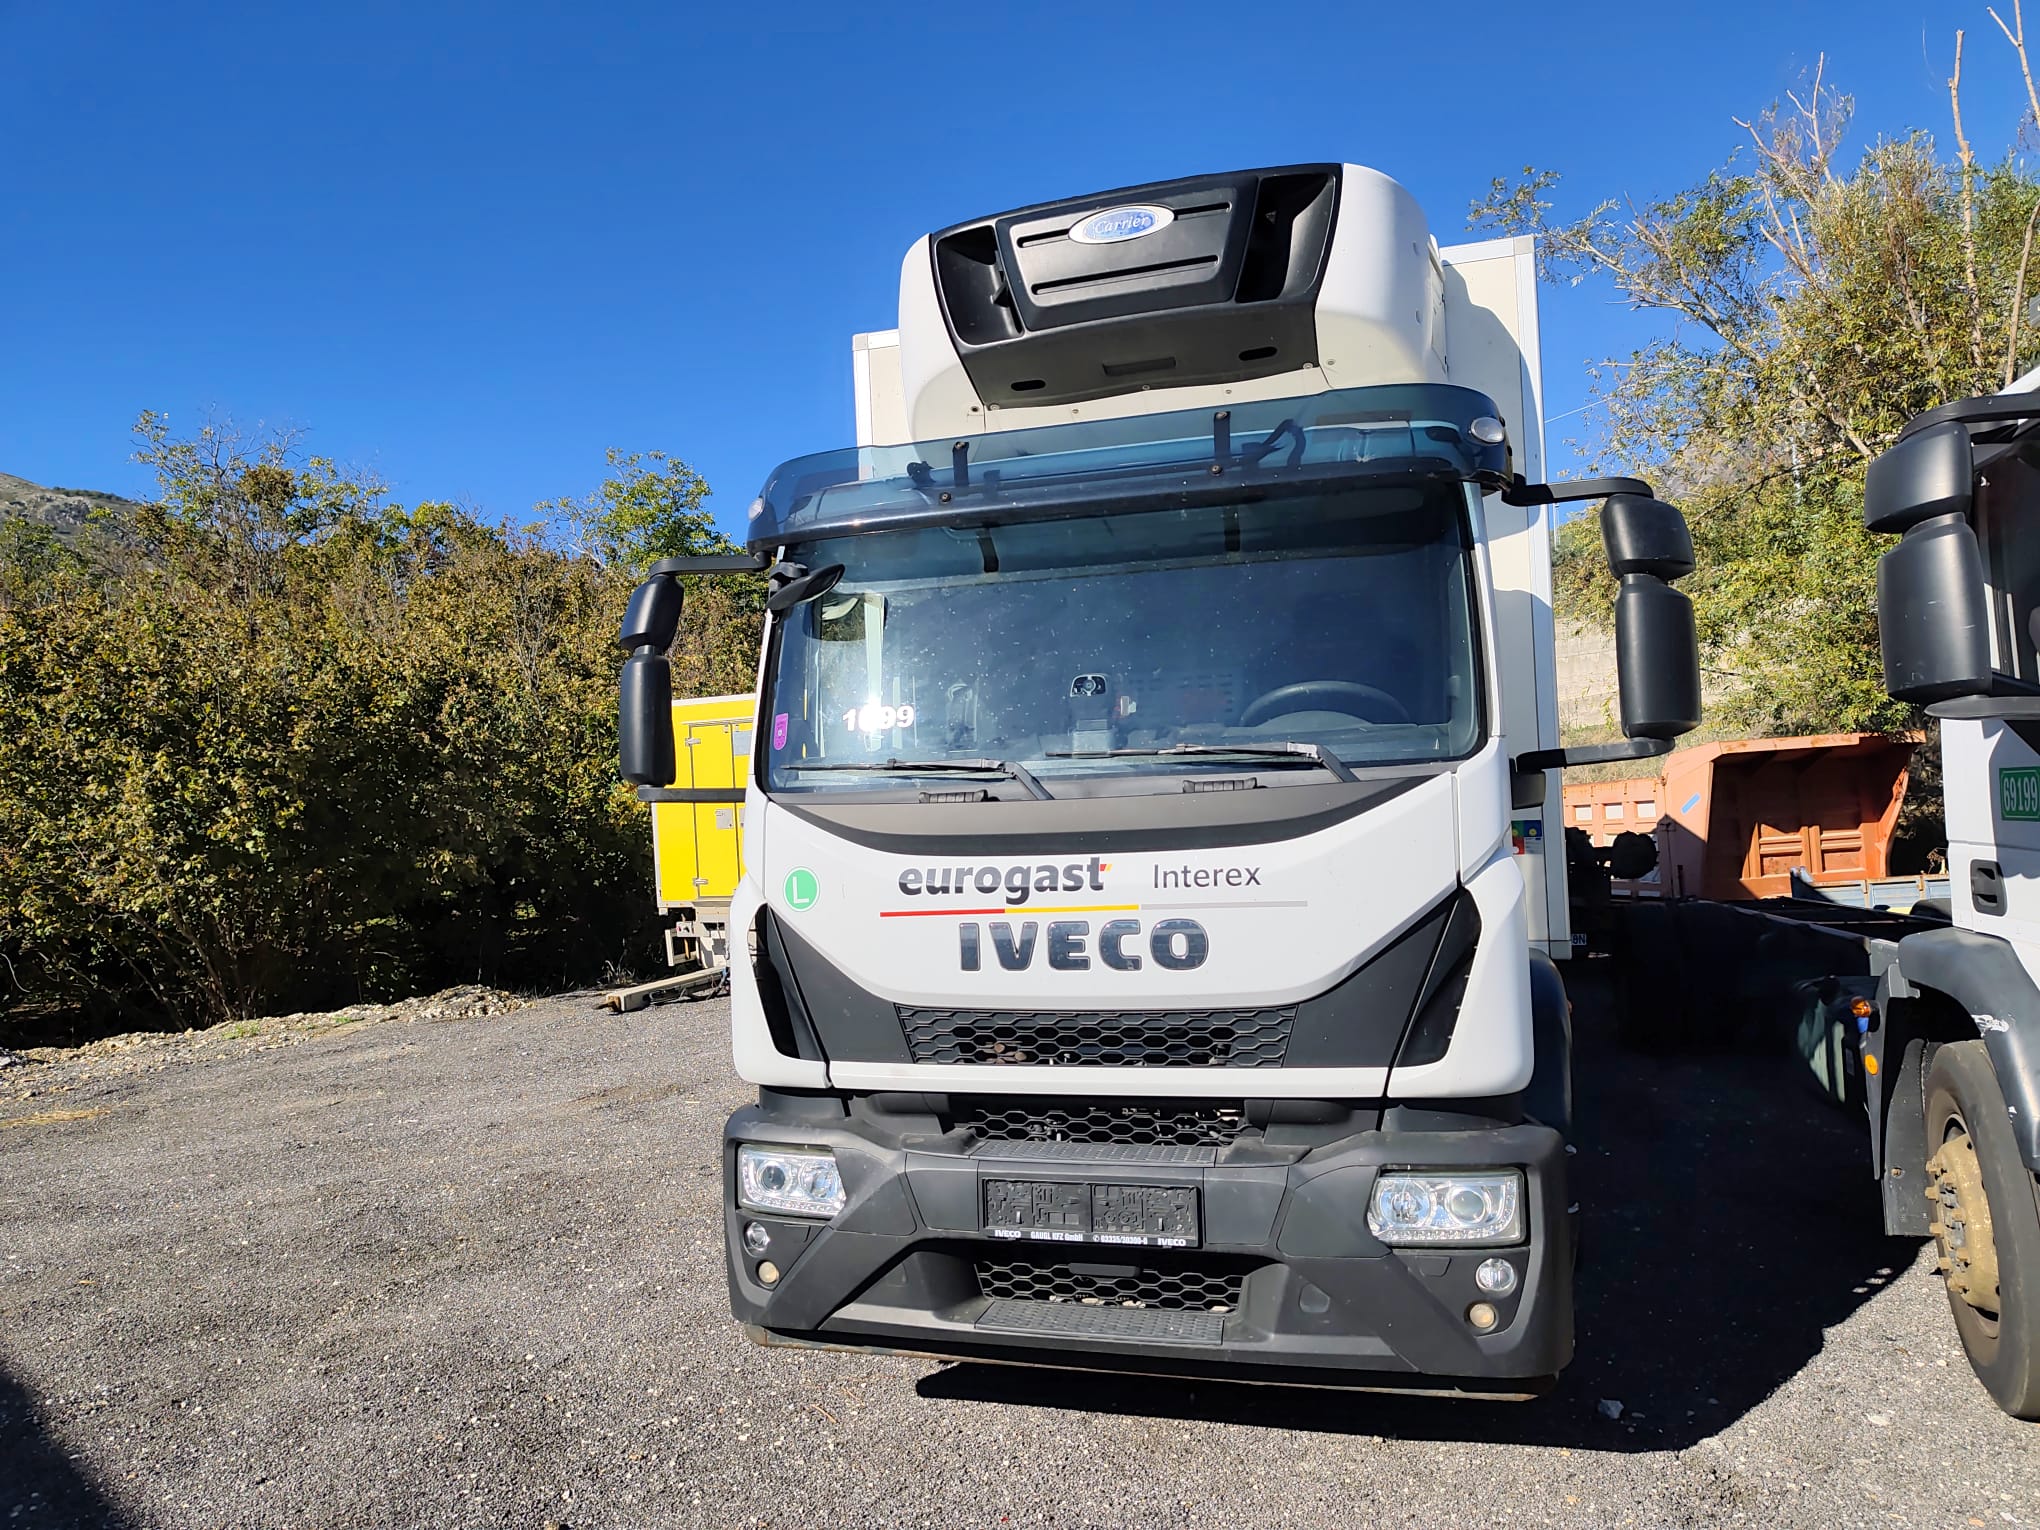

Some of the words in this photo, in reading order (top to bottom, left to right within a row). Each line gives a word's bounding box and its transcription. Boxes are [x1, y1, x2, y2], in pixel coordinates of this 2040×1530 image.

[1095, 213, 1149, 234] Carrier
[843, 705, 915, 732] 199
[2003, 776, 2038, 812] 69199
[792, 876, 810, 904] L
[898, 857, 1106, 906] eurogast
[1153, 864, 1262, 889] Interex
[959, 918, 1209, 972] IVECO
[994, 1229, 1022, 1238] IVECO
[1064, 1233, 1084, 1242] GmbH
[1157, 1237, 1186, 1247] IVECO
